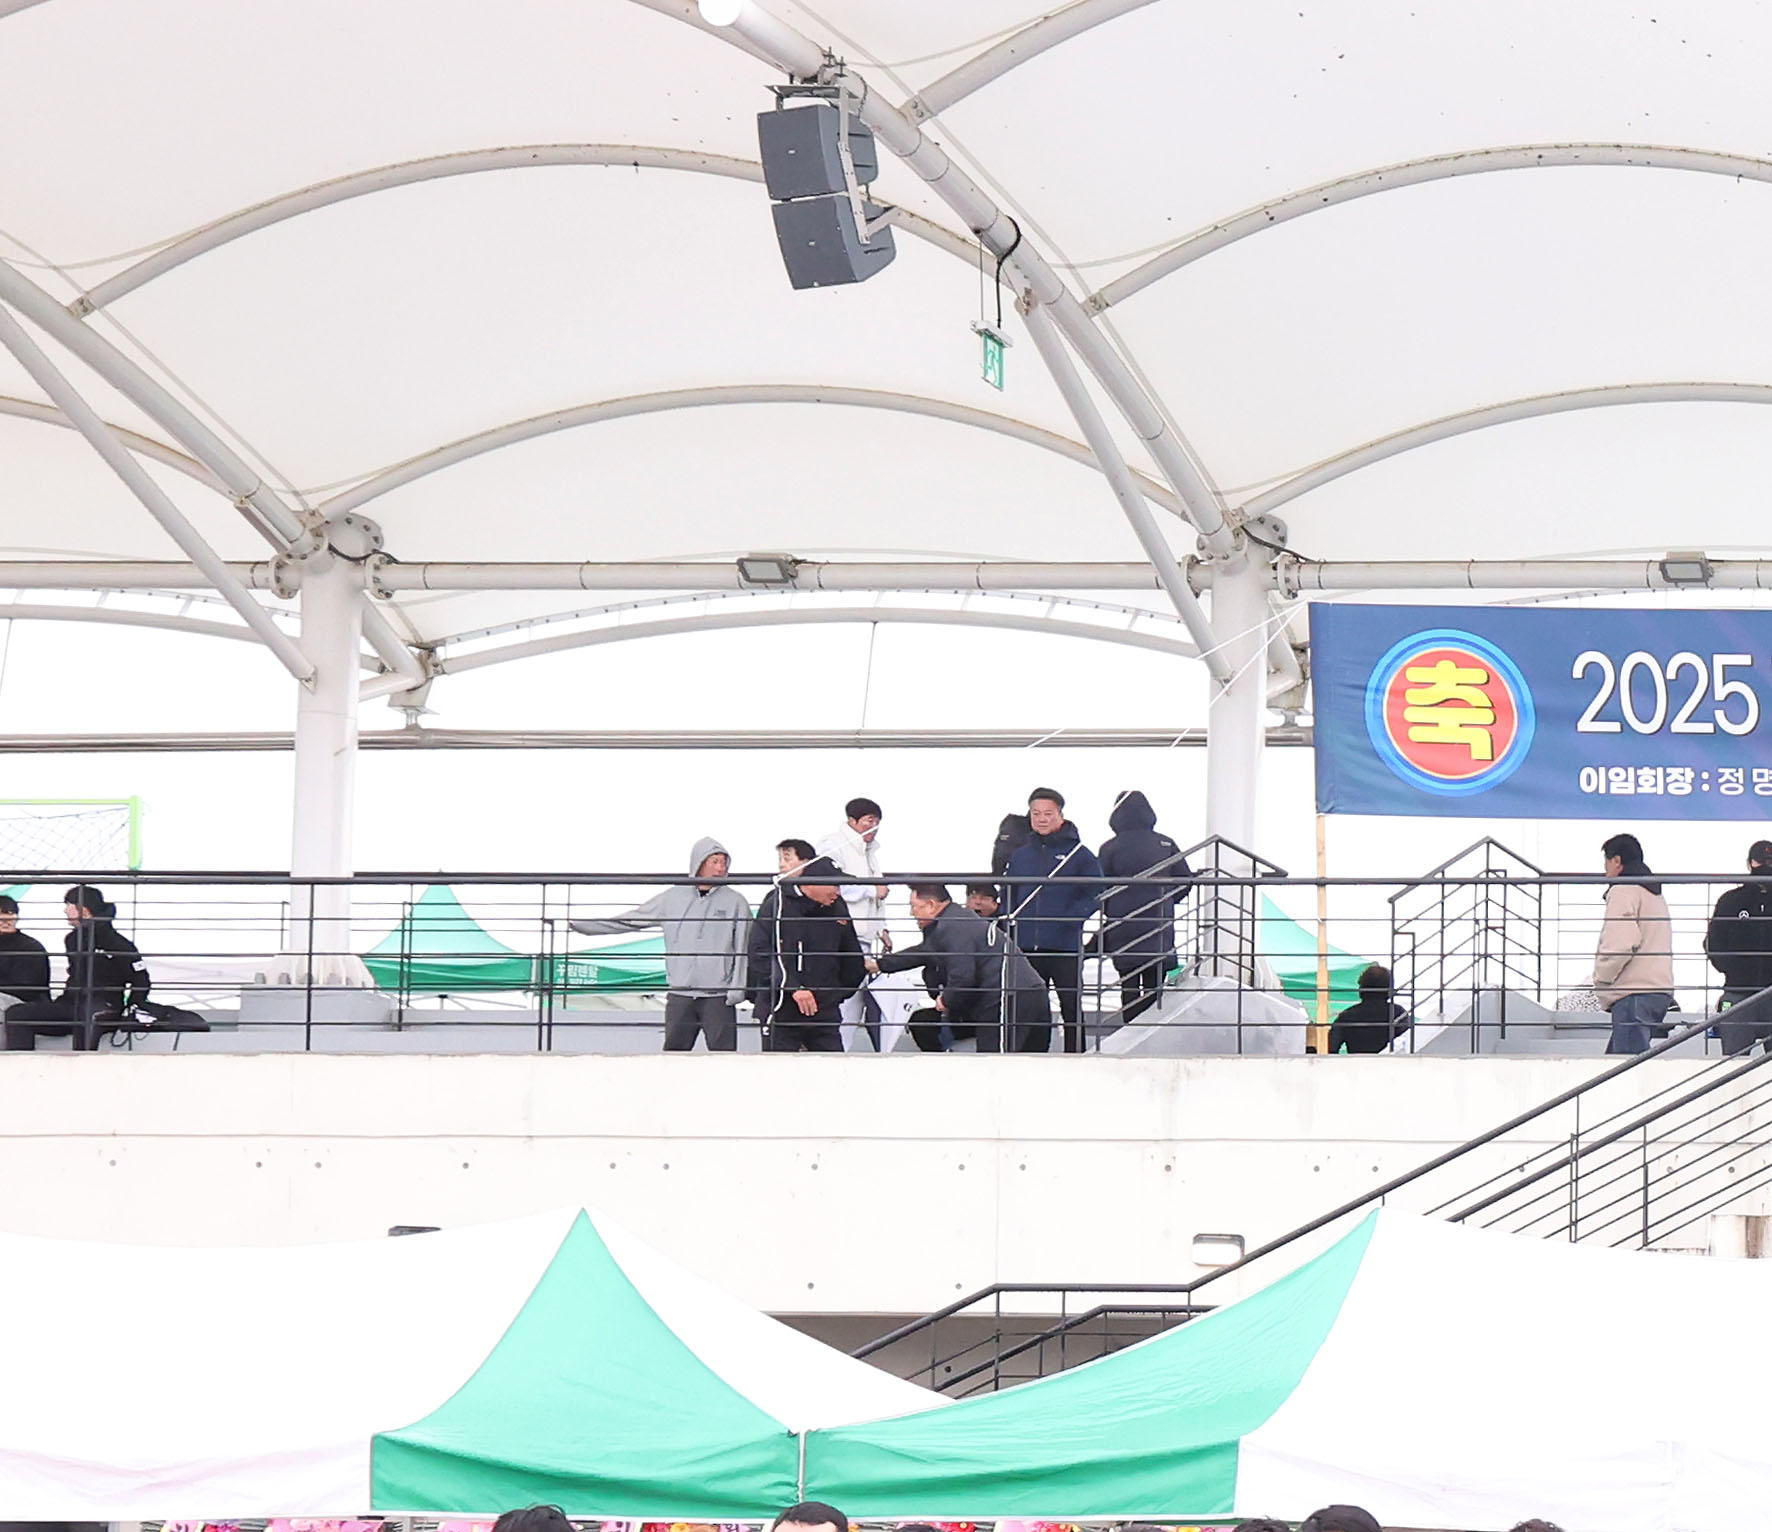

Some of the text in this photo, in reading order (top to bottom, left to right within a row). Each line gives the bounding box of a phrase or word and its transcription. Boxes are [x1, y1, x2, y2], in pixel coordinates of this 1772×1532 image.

[1403, 659, 1496, 760] 축
[1572, 650, 1759, 735] 2025
[1579, 766, 1695, 796] 이임회장
[1717, 767, 1745, 796] 정
